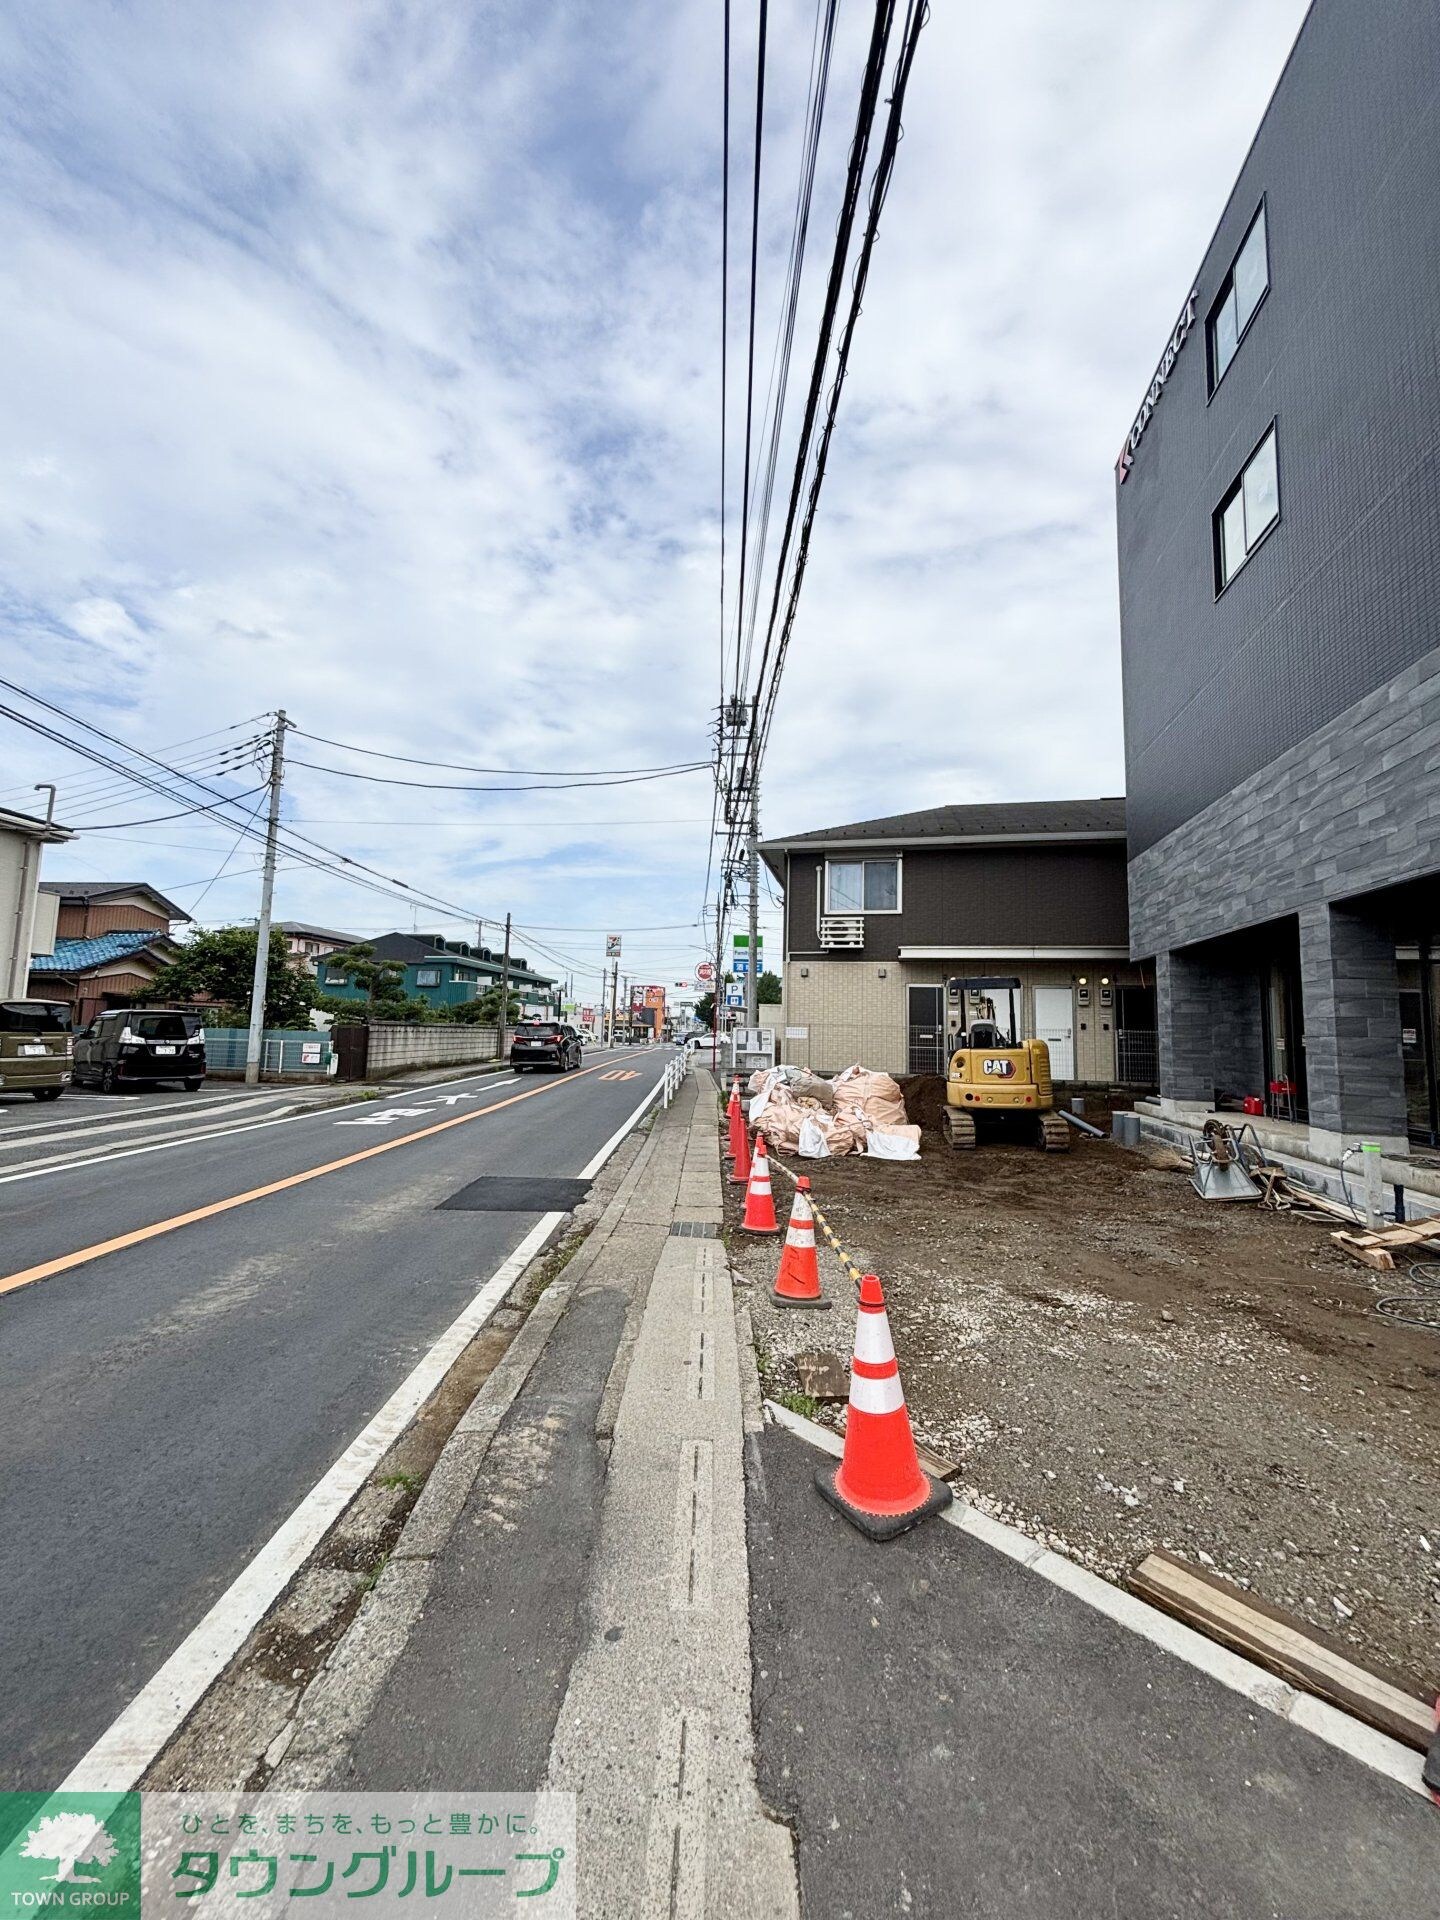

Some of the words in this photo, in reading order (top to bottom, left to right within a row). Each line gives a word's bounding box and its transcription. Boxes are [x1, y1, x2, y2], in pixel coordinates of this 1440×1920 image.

[731, 985, 739, 994] P
[983, 1059, 1009, 1075] CAT
[598, 1069, 643, 1081] 40
